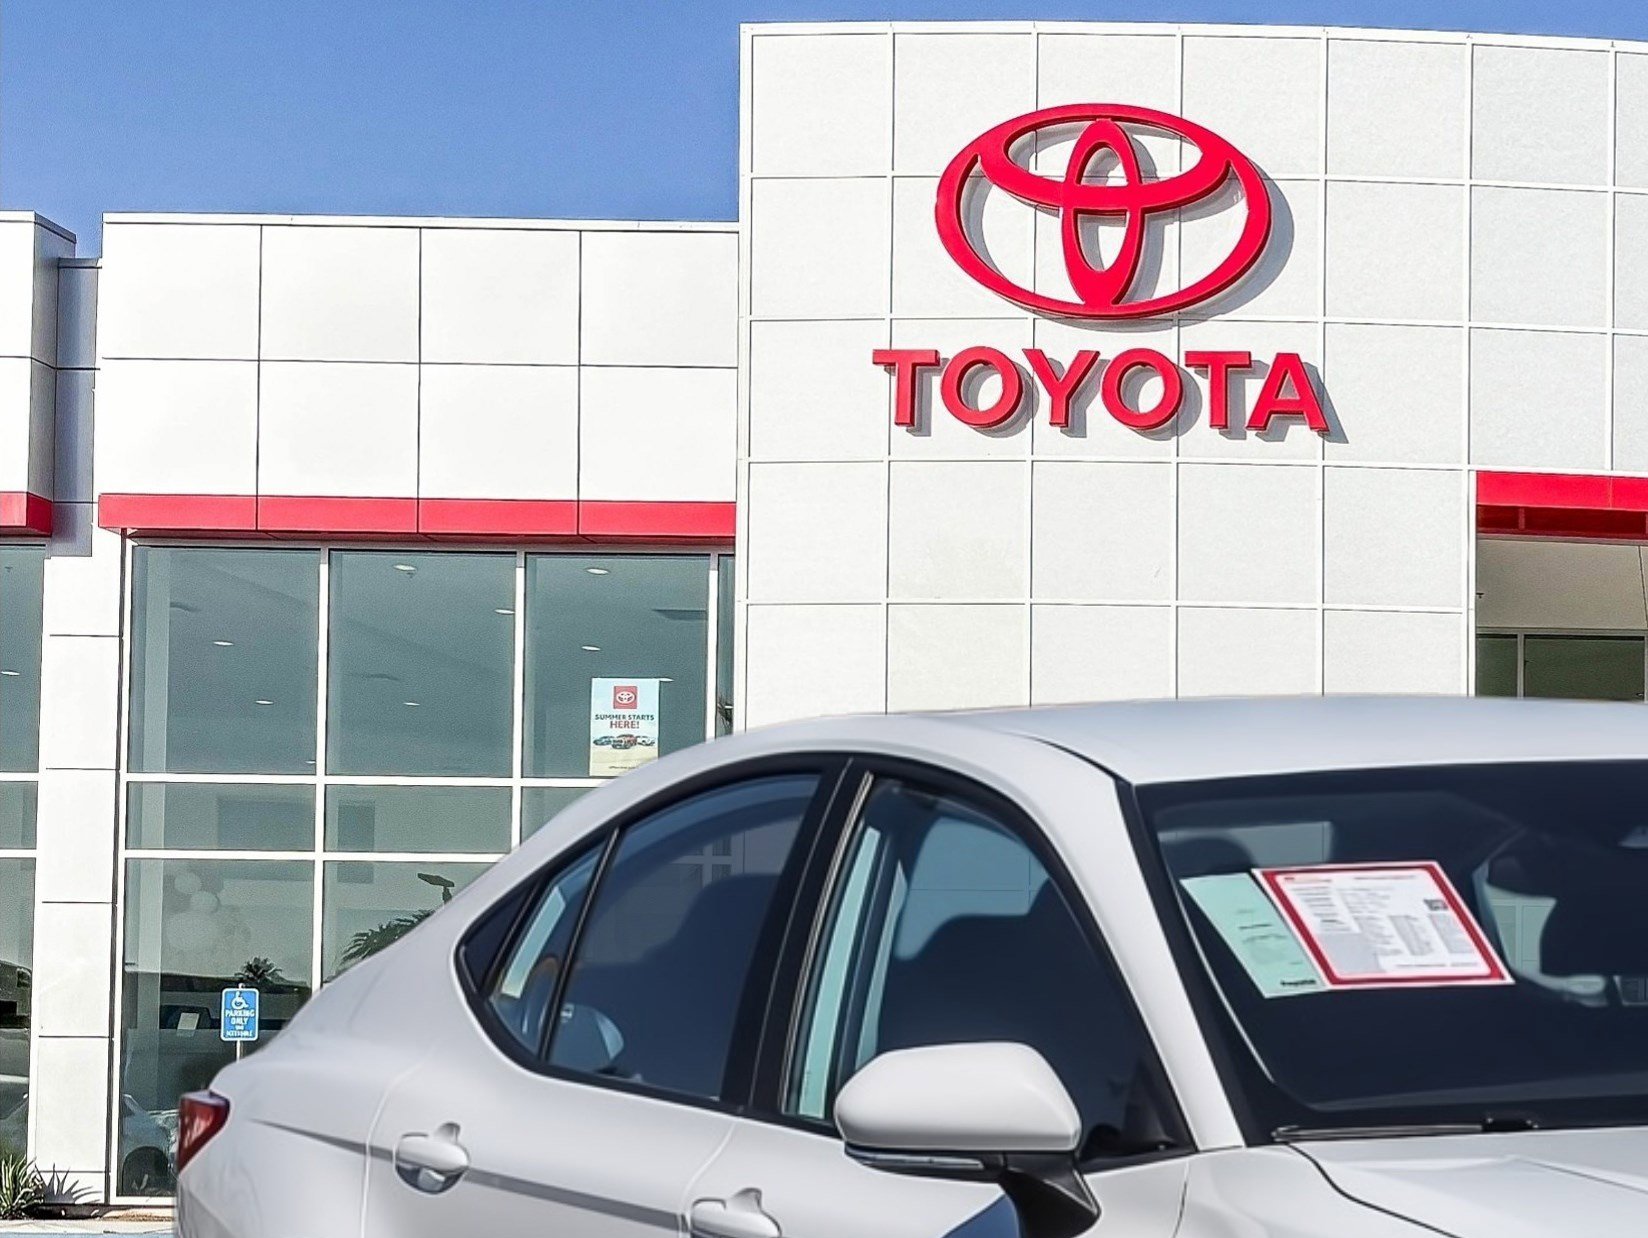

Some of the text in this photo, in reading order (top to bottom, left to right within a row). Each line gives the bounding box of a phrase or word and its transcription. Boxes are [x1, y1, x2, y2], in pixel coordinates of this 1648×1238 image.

[872, 345, 1330, 432] TOYOTA
[609, 720, 640, 729] HERE!
[230, 1017, 249, 1025] ONLY
